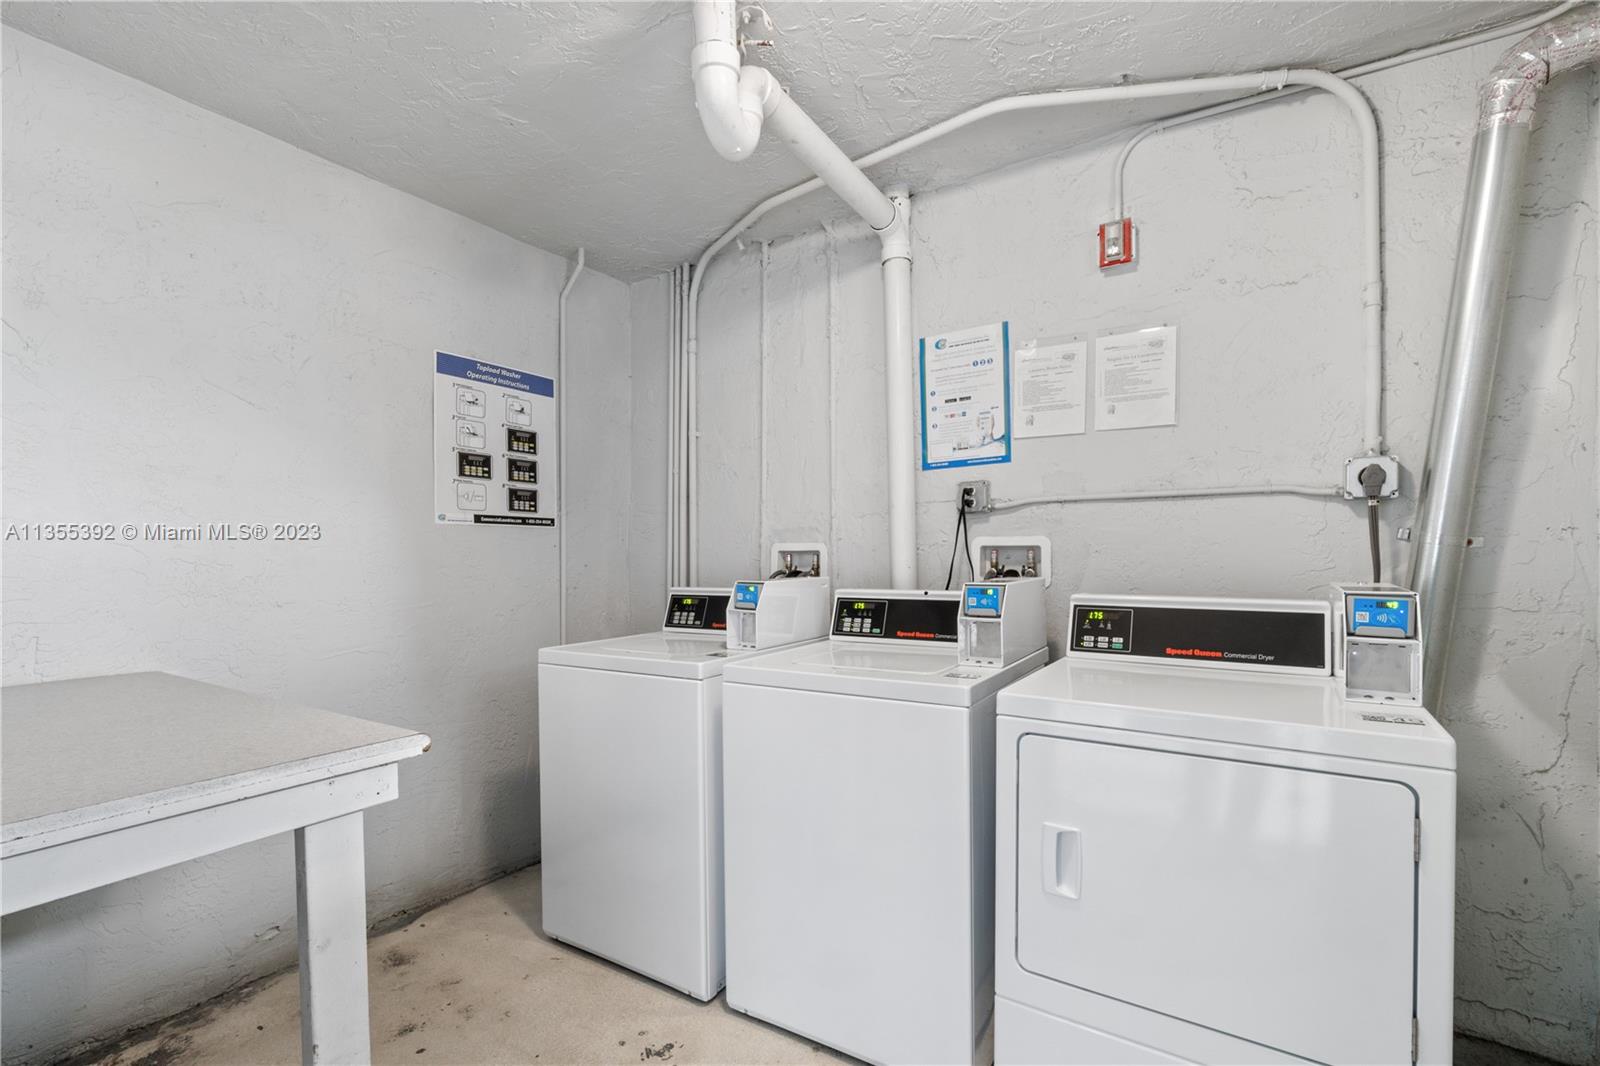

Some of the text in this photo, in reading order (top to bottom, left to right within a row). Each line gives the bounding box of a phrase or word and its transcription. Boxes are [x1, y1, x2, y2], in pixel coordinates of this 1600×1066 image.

[476, 363, 521, 380] Topload Washer
[466, 370, 530, 391] Operating Instructions
[895, 630, 915, 638] Speed
[1165, 647, 1276, 662] Speed Queen Commercial Dryer
